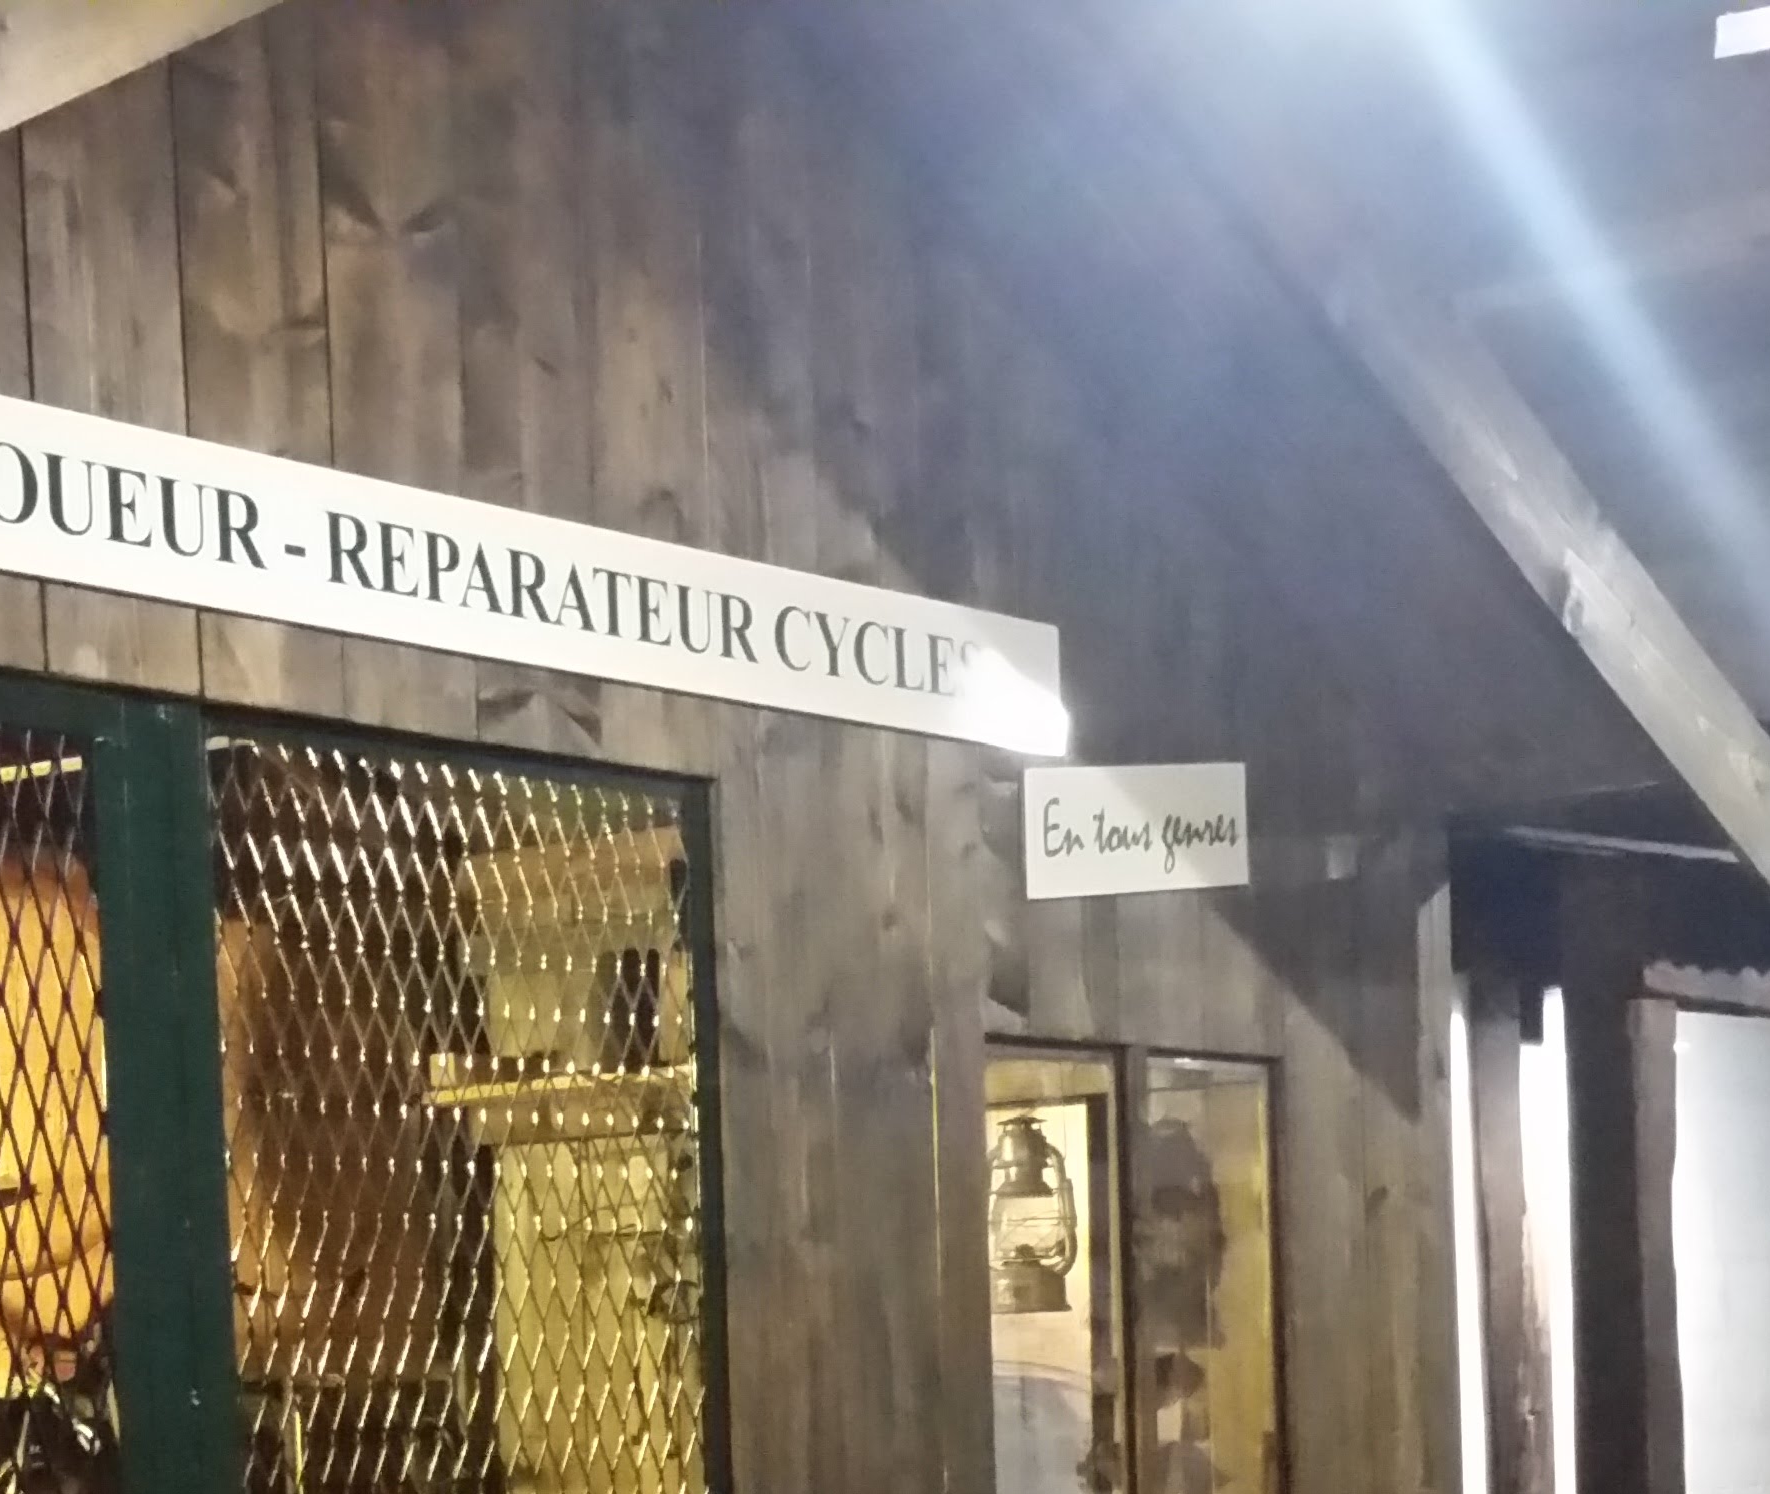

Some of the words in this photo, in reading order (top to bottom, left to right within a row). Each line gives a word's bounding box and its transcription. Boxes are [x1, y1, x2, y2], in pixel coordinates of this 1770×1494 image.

[325, 510, 758, 663] REPARATEUR
[1043, 797, 1085, 858] En
[1092, 805, 1153, 854] tous
[1161, 813, 1238, 874] genres
